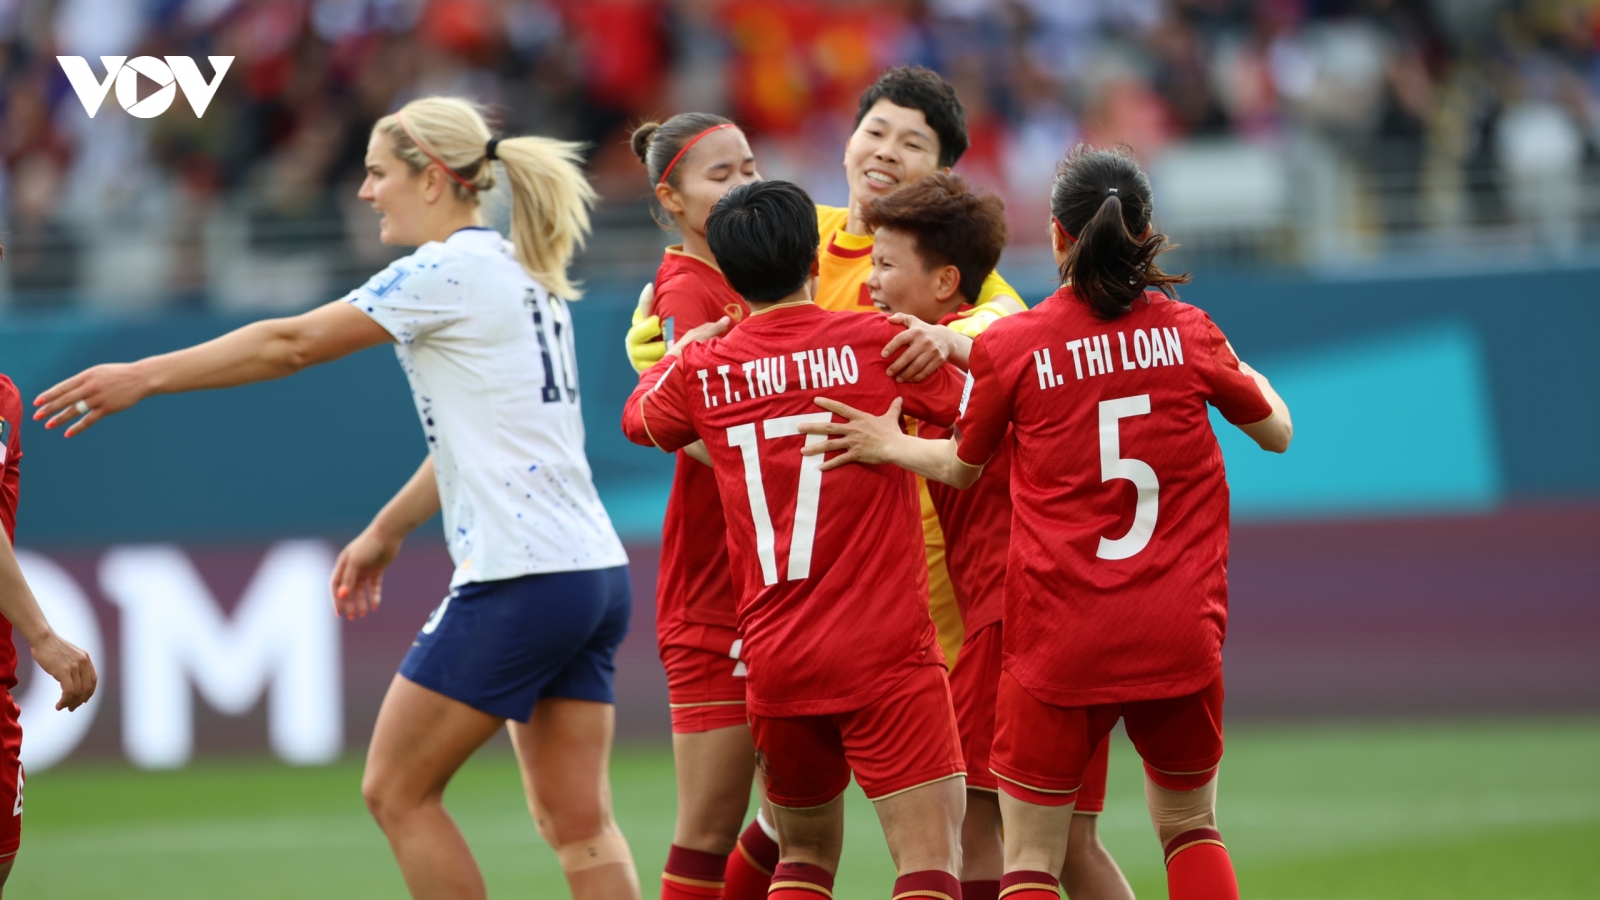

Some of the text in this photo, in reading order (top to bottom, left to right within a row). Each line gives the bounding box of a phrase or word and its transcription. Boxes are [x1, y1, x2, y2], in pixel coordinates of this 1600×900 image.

[697, 345, 859, 408] T. T. THU THAO
[1033, 327, 1184, 390] H. THI LOAN
[727, 411, 832, 586] 17
[1096, 394, 1159, 560] 5
